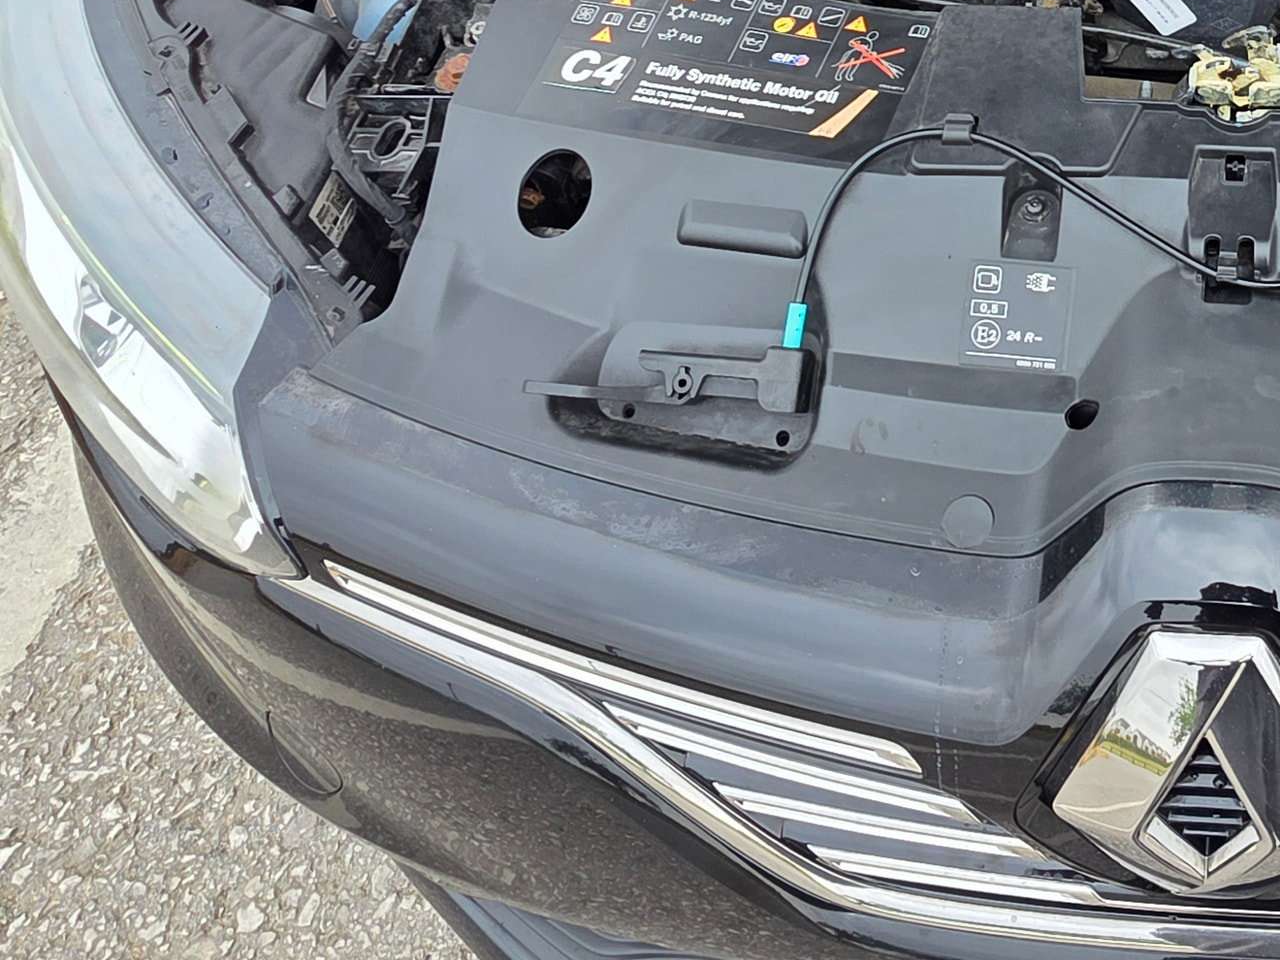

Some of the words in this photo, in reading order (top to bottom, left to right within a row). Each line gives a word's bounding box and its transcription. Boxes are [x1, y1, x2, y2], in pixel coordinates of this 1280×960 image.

[688, 10, 733, 26] R-1234yf
[678, 32, 703, 44] PAG
[561, 49, 631, 86] C4
[645, 61, 686, 80] Fully
[686, 68, 761, 92] Synthetic
[763, 81, 814, 101] Motor
[815, 89, 840, 105] Oil
[977, 326, 997, 343] E2
[1006, 329, 1021, 342] 24
